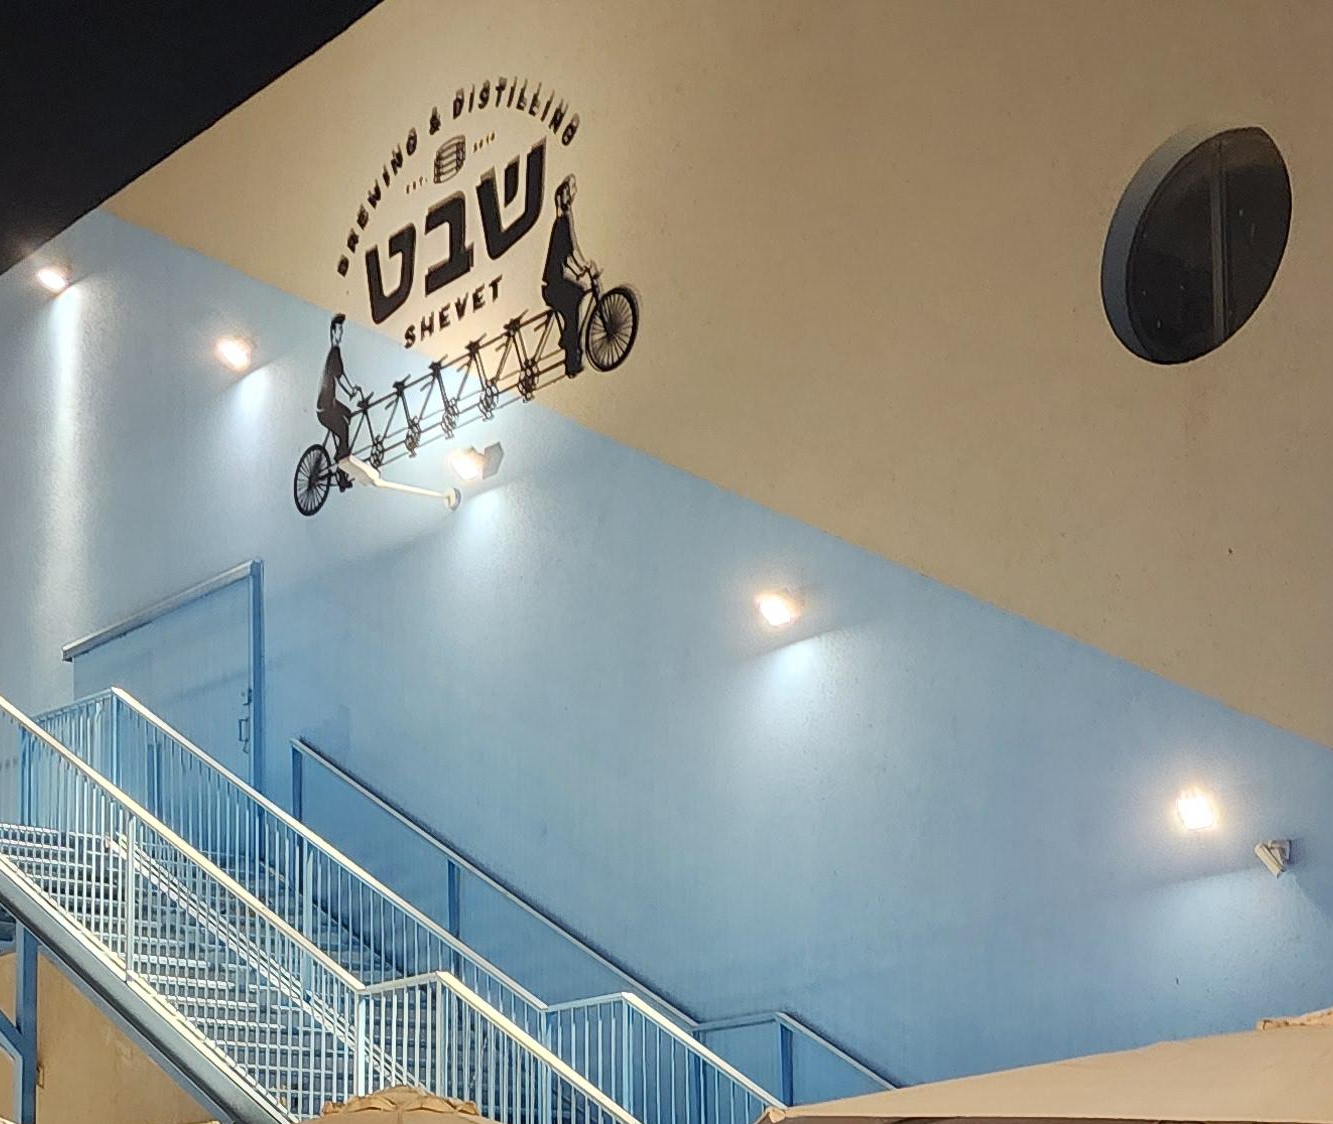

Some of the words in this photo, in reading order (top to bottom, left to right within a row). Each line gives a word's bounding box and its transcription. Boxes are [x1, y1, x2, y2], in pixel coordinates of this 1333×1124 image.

[337, 127, 417, 277] BREWING
[453, 76, 580, 146] DISTILLING
[365, 136, 546, 325] שבט
[404, 274, 502, 350] SHEVET
